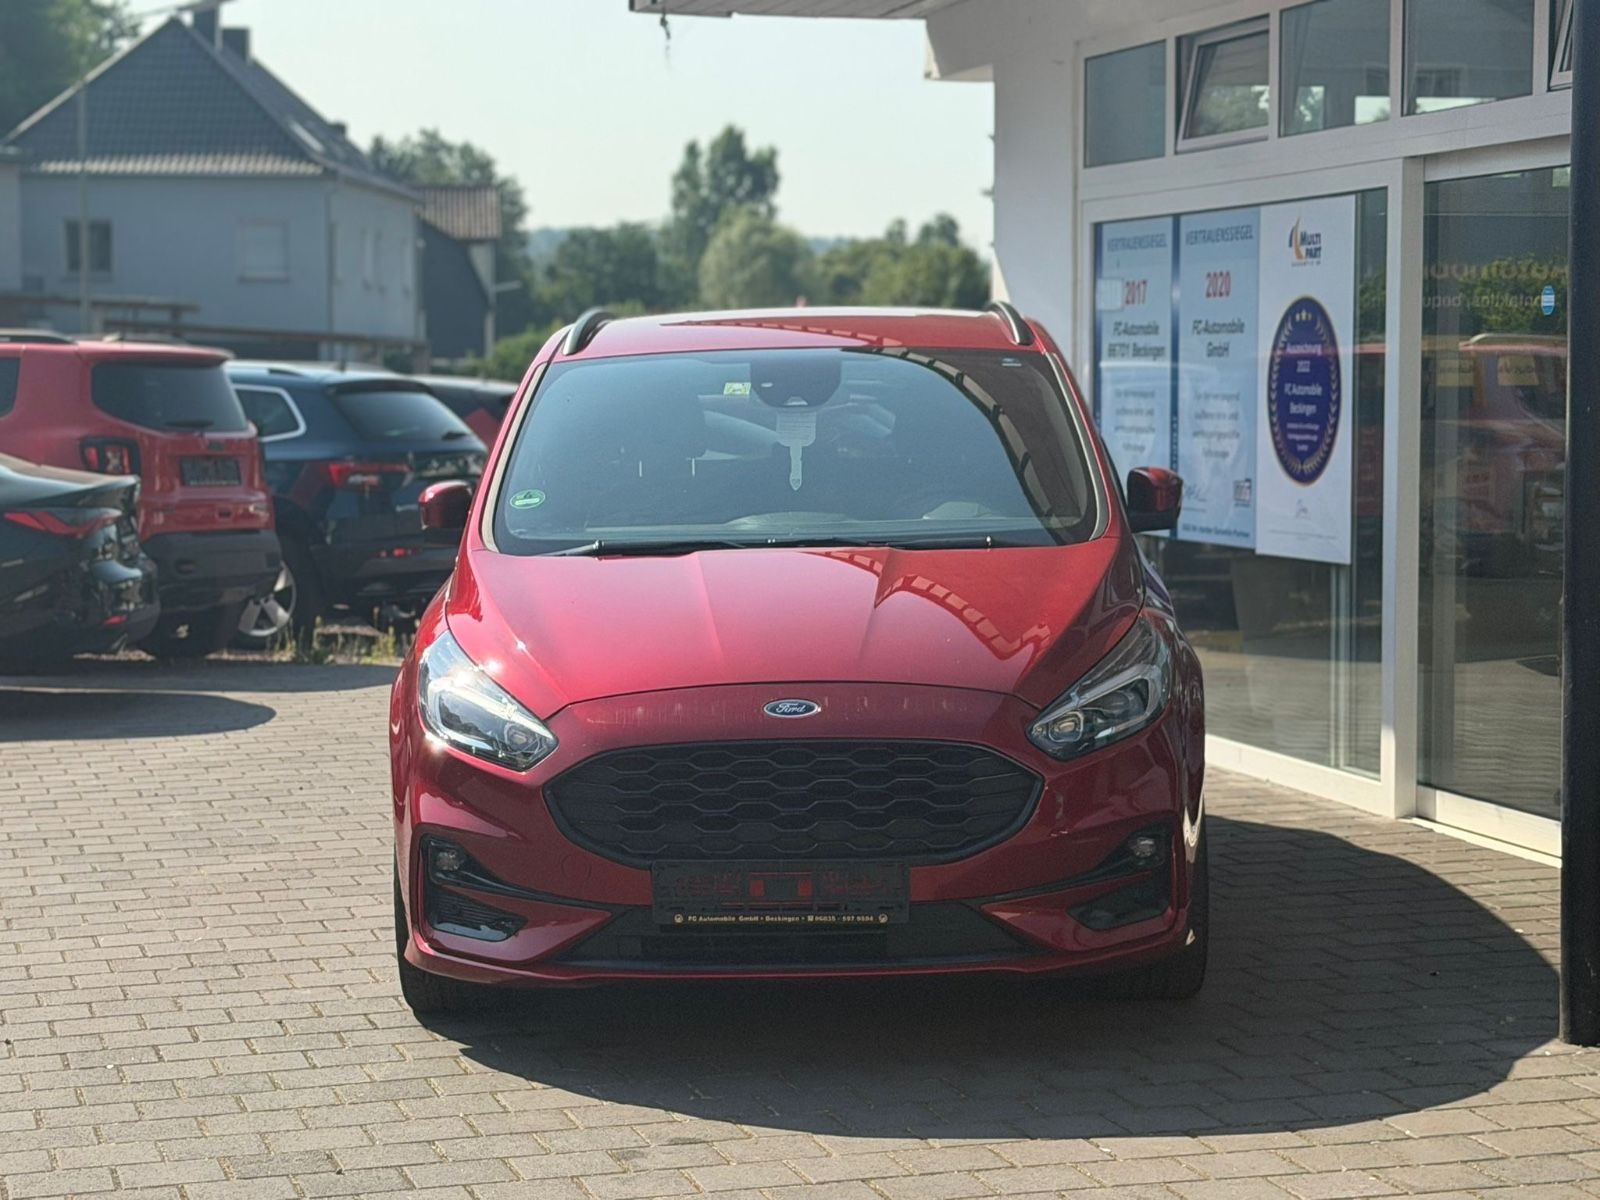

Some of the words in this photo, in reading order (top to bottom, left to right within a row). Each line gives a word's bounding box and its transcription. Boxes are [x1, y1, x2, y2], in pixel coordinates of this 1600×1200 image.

[1185, 225, 1254, 246] VERTRAUENSSIEGEL
[1125, 279, 1148, 305] 2017
[1205, 270, 1231, 298] 2020
[1206, 341, 1230, 358] GmbH
[776, 702, 806, 713] Ford
[765, 915, 800, 923] Beckingen
